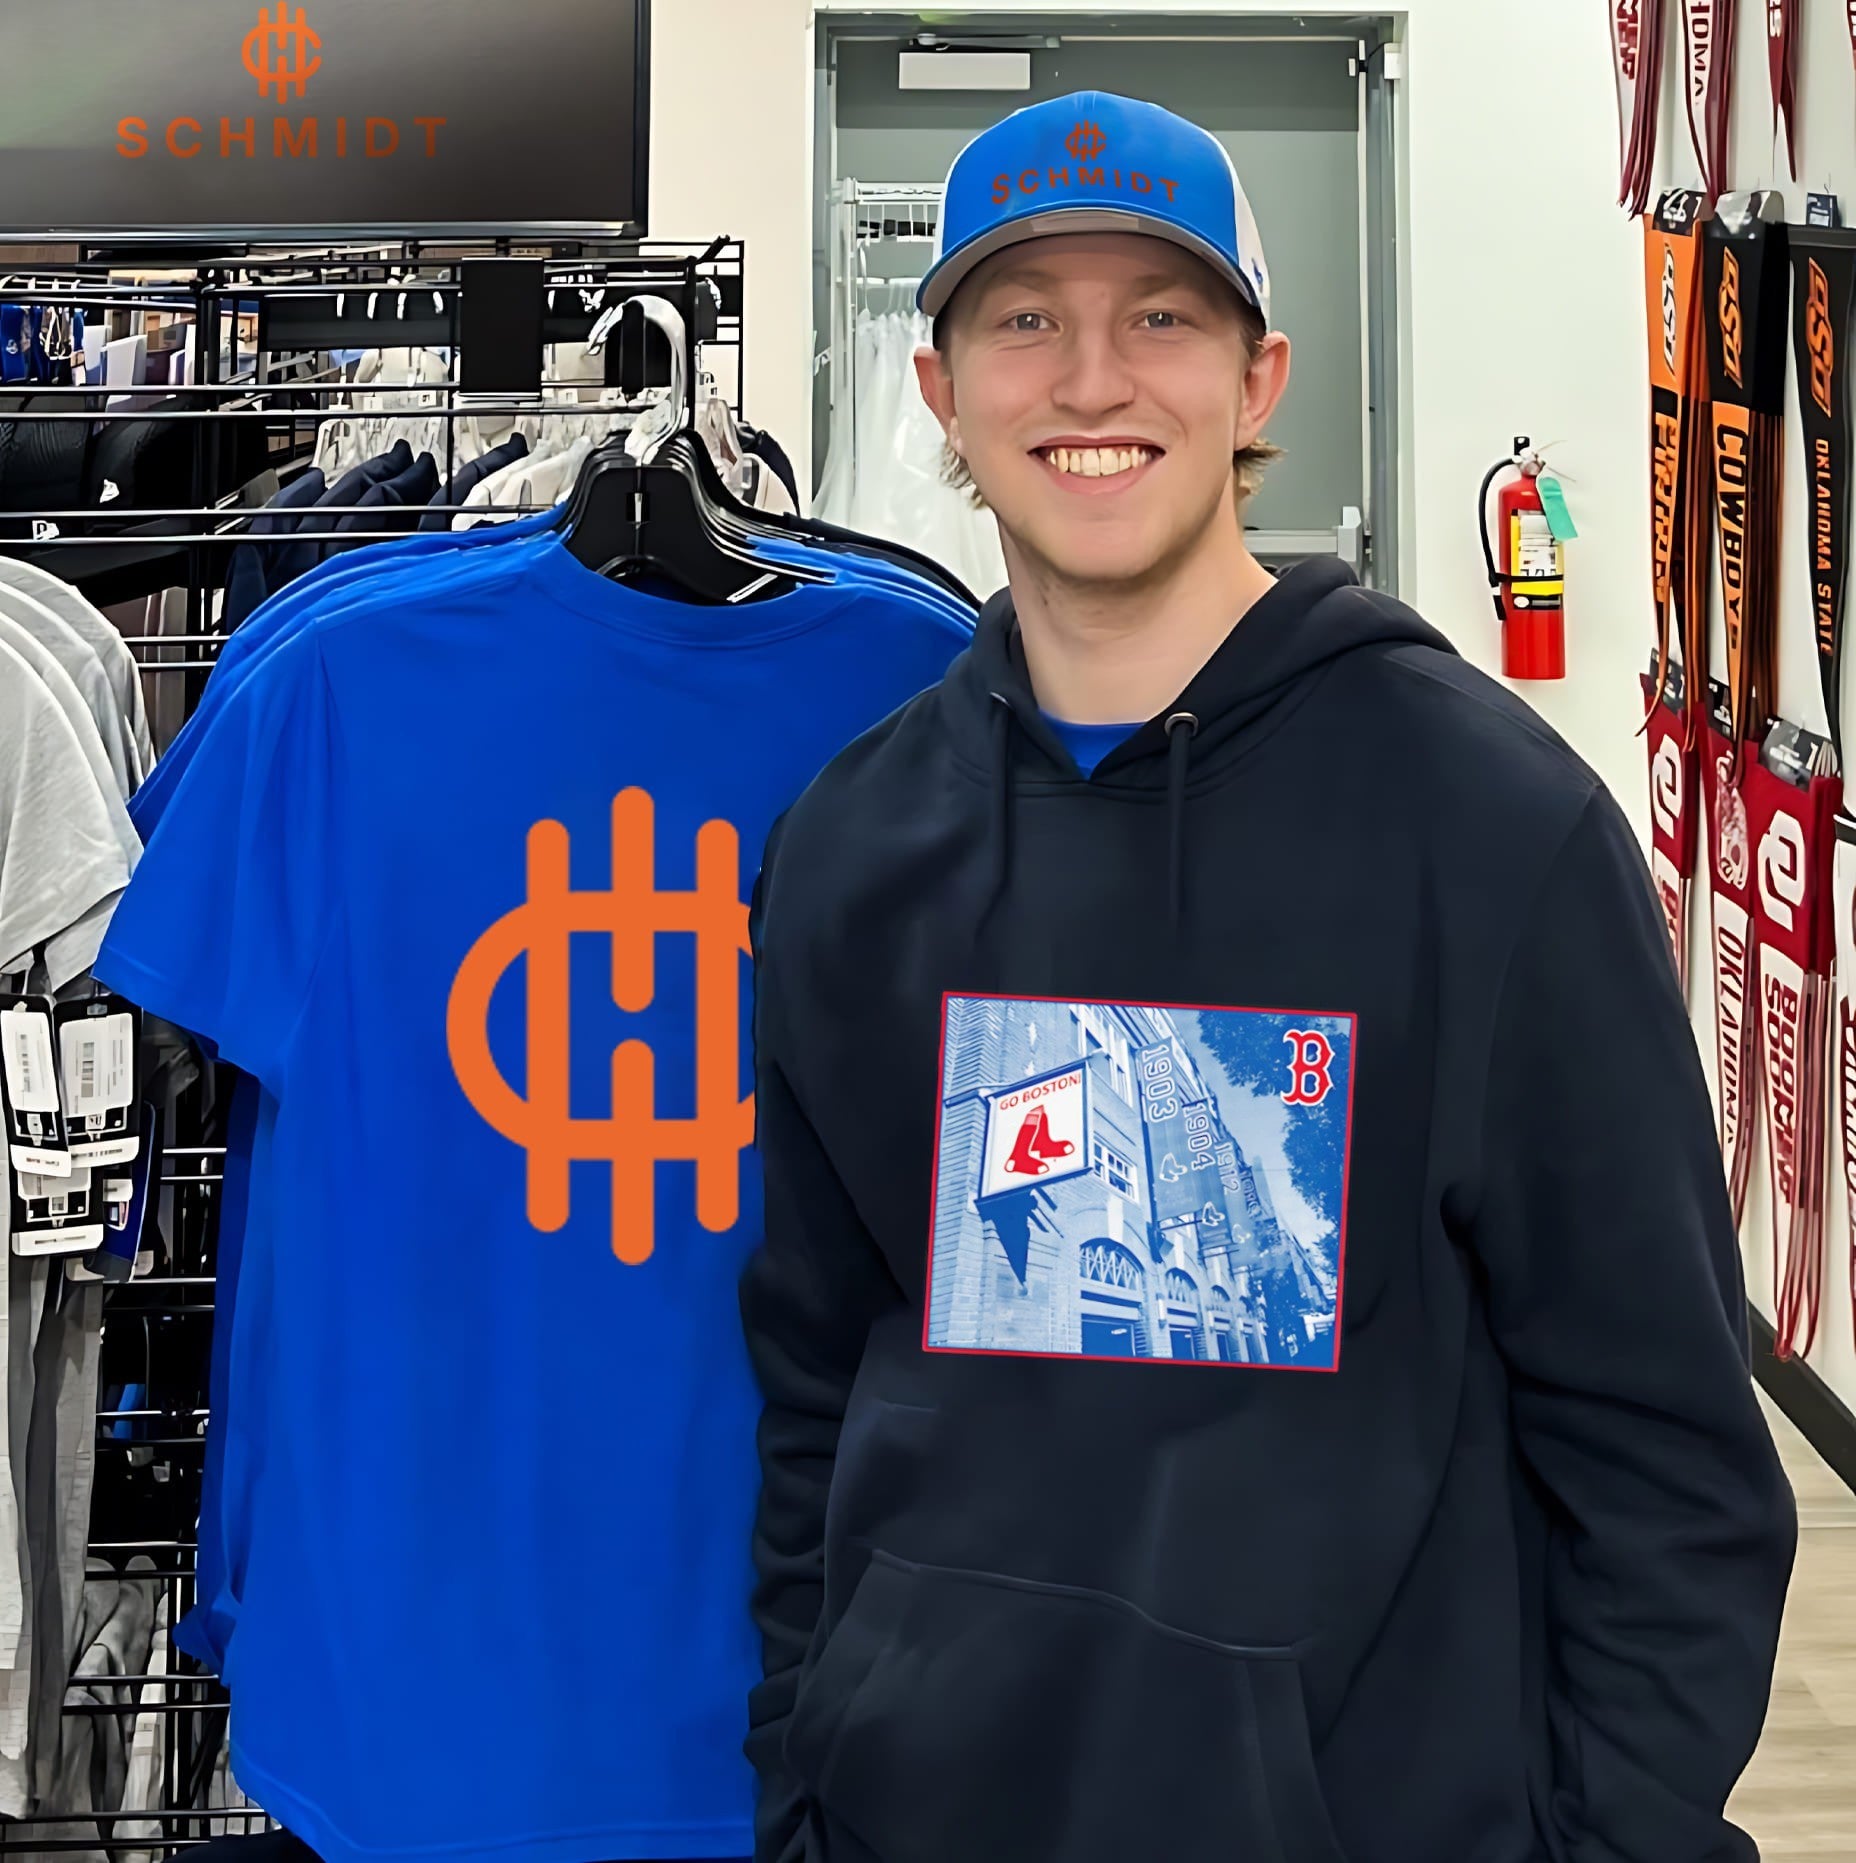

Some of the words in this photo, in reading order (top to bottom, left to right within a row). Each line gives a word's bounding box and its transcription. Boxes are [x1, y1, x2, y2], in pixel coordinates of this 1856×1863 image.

[116, 117, 446, 158] SCHMIDT
[991, 166, 1179, 205] SCHMIDT
[1142, 1044, 1177, 1123] 1903
[1281, 1029, 1336, 1106] B
[1000, 1096, 1018, 1110] GO
[1183, 1103, 1216, 1171] 1904
